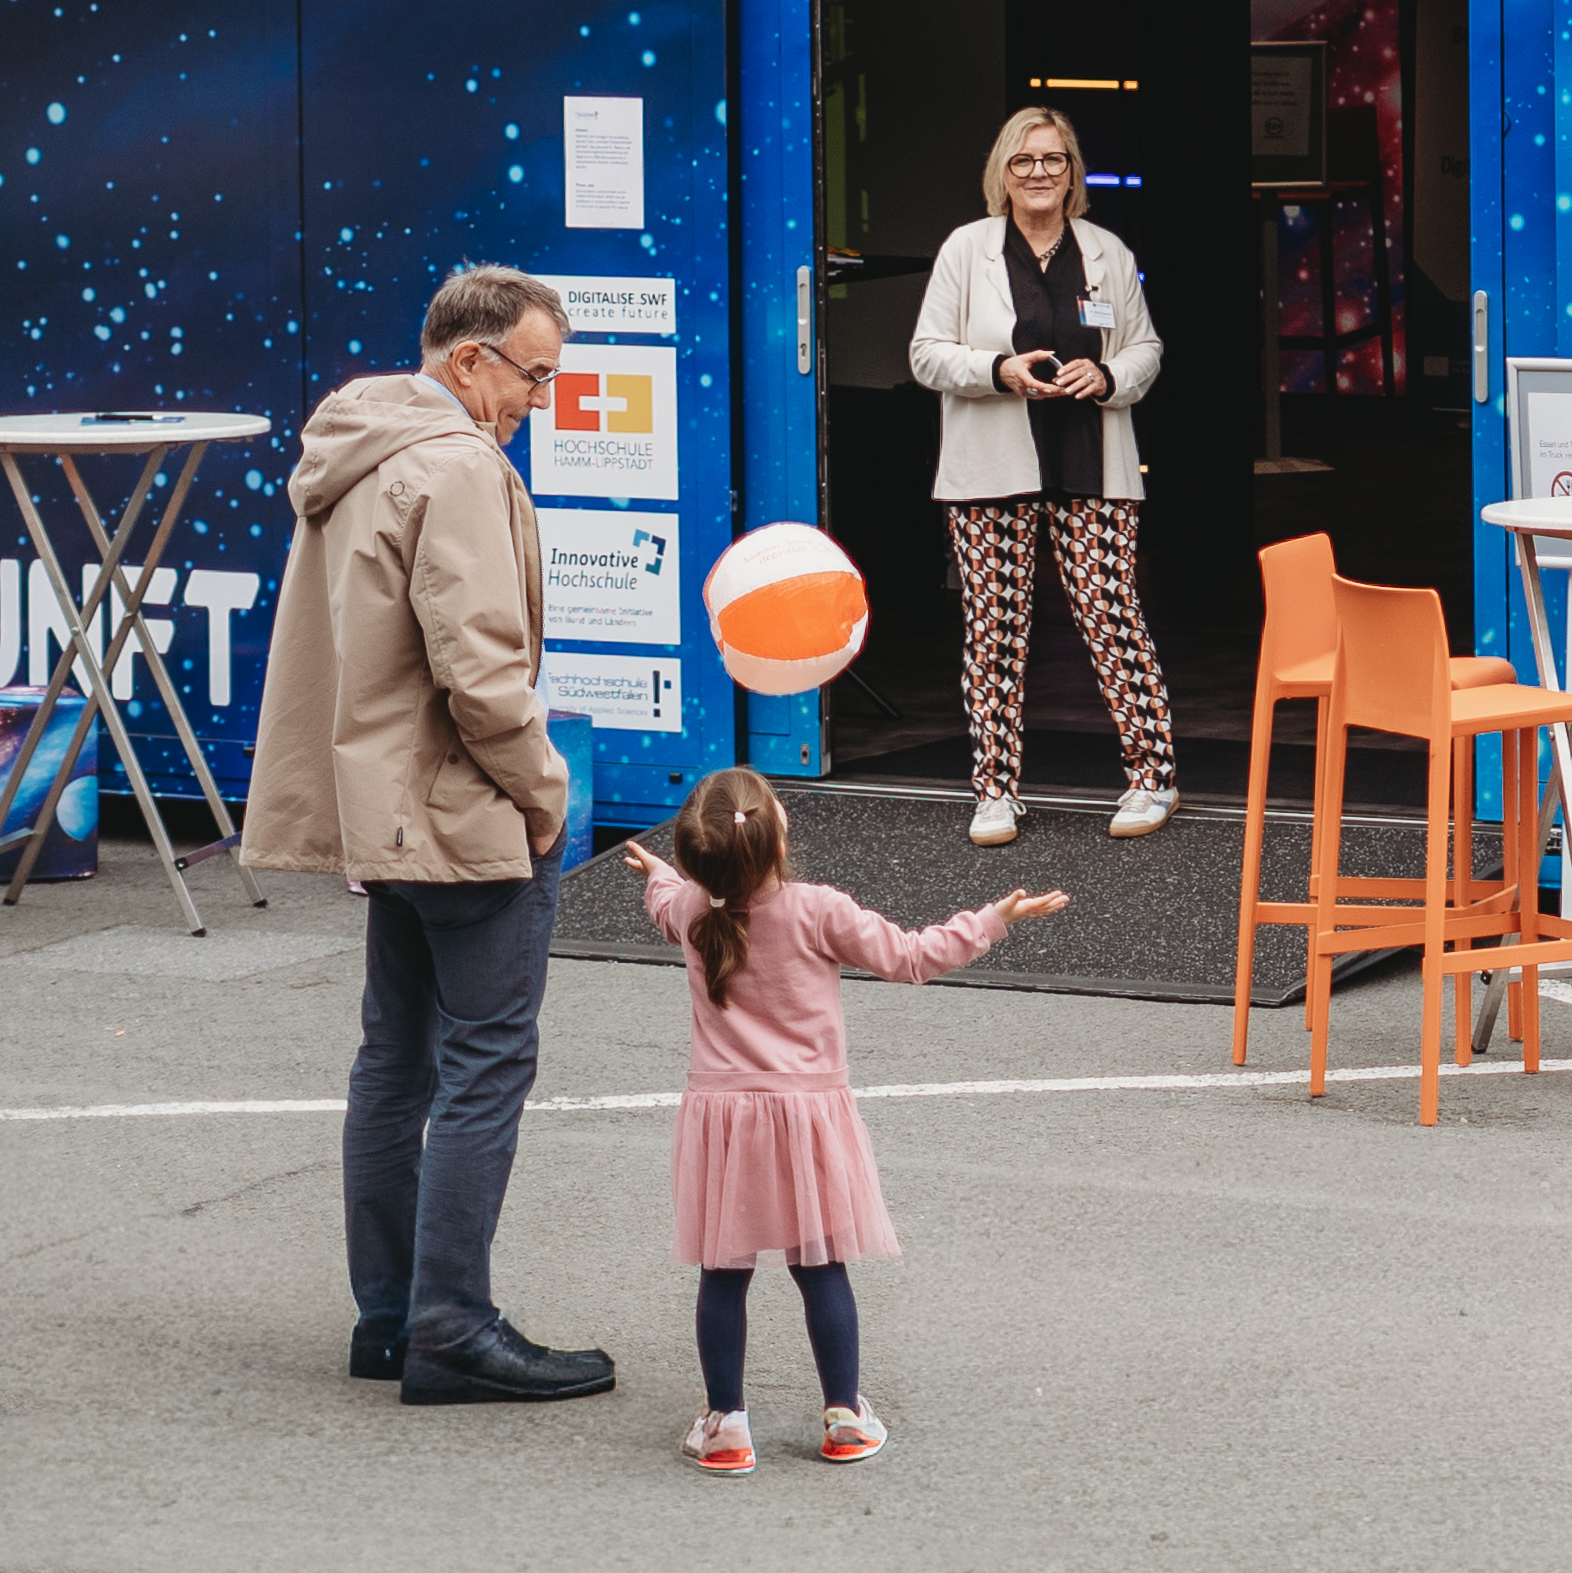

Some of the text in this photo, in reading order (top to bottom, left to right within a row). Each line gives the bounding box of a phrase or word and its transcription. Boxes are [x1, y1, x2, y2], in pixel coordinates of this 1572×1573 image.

[568, 290, 668, 306] DIGITALISE_SWF
[568, 306, 668, 320] create future
[554, 439, 654, 457] HOCHSCHULE
[554, 456, 654, 470] HAMM-LIPPSTADT
[550, 547, 639, 568] Innovative
[548, 569, 638, 590] Hochschule
